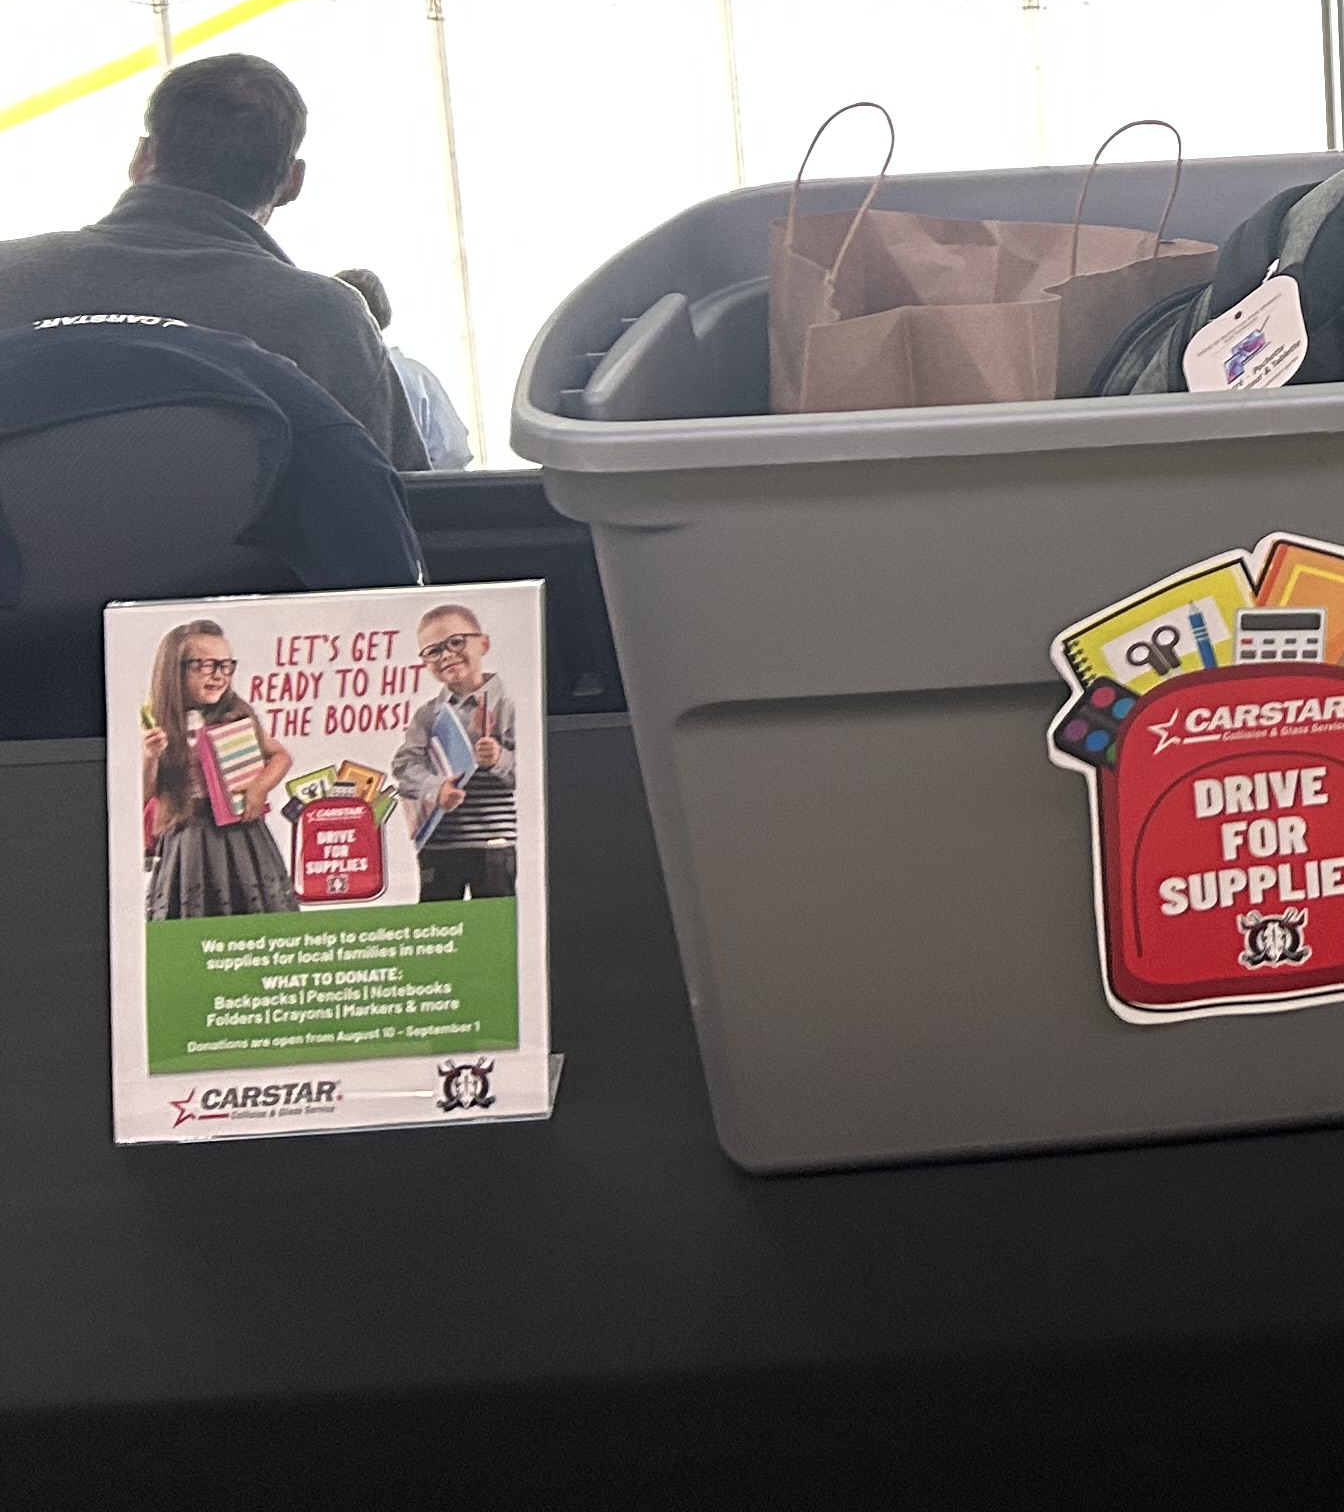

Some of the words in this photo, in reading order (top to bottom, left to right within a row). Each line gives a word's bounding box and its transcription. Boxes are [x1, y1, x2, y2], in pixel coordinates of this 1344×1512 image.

[275, 633, 340, 667] LET'S
[351, 630, 400, 662] GET
[249, 674, 324, 704] READY
[335, 668, 368, 698] TO
[380, 664, 427, 696] HIT
[267, 706, 310, 738] THE
[326, 701, 412, 736] BOOKS!
[1192, 766, 1329, 820] DRIVE
[1220, 815, 1309, 861] FOR
[201, 938, 225, 954] We
[227, 936, 266, 952] need
[268, 937, 301, 952] your
[304, 931, 337, 947] help
[339, 931, 357, 944] to
[358, 927, 411, 943] collect
[413, 922, 464, 939] school
[206, 952, 271, 971] supplies
[273, 951, 295, 965] for
[298, 948, 334, 964] local
[399, 942, 414, 956] in
[416, 939, 458, 956] need.
[261, 973, 309, 990] WHAT
[312, 971, 333, 986] TO
[335, 967, 403, 985] DONATE:
[206, 1012, 263, 1027] Folders
[420, 998, 461, 1013] more
[214, 992, 298, 1010] Backpacks
[201, 1080, 336, 1110] CARSTAR
